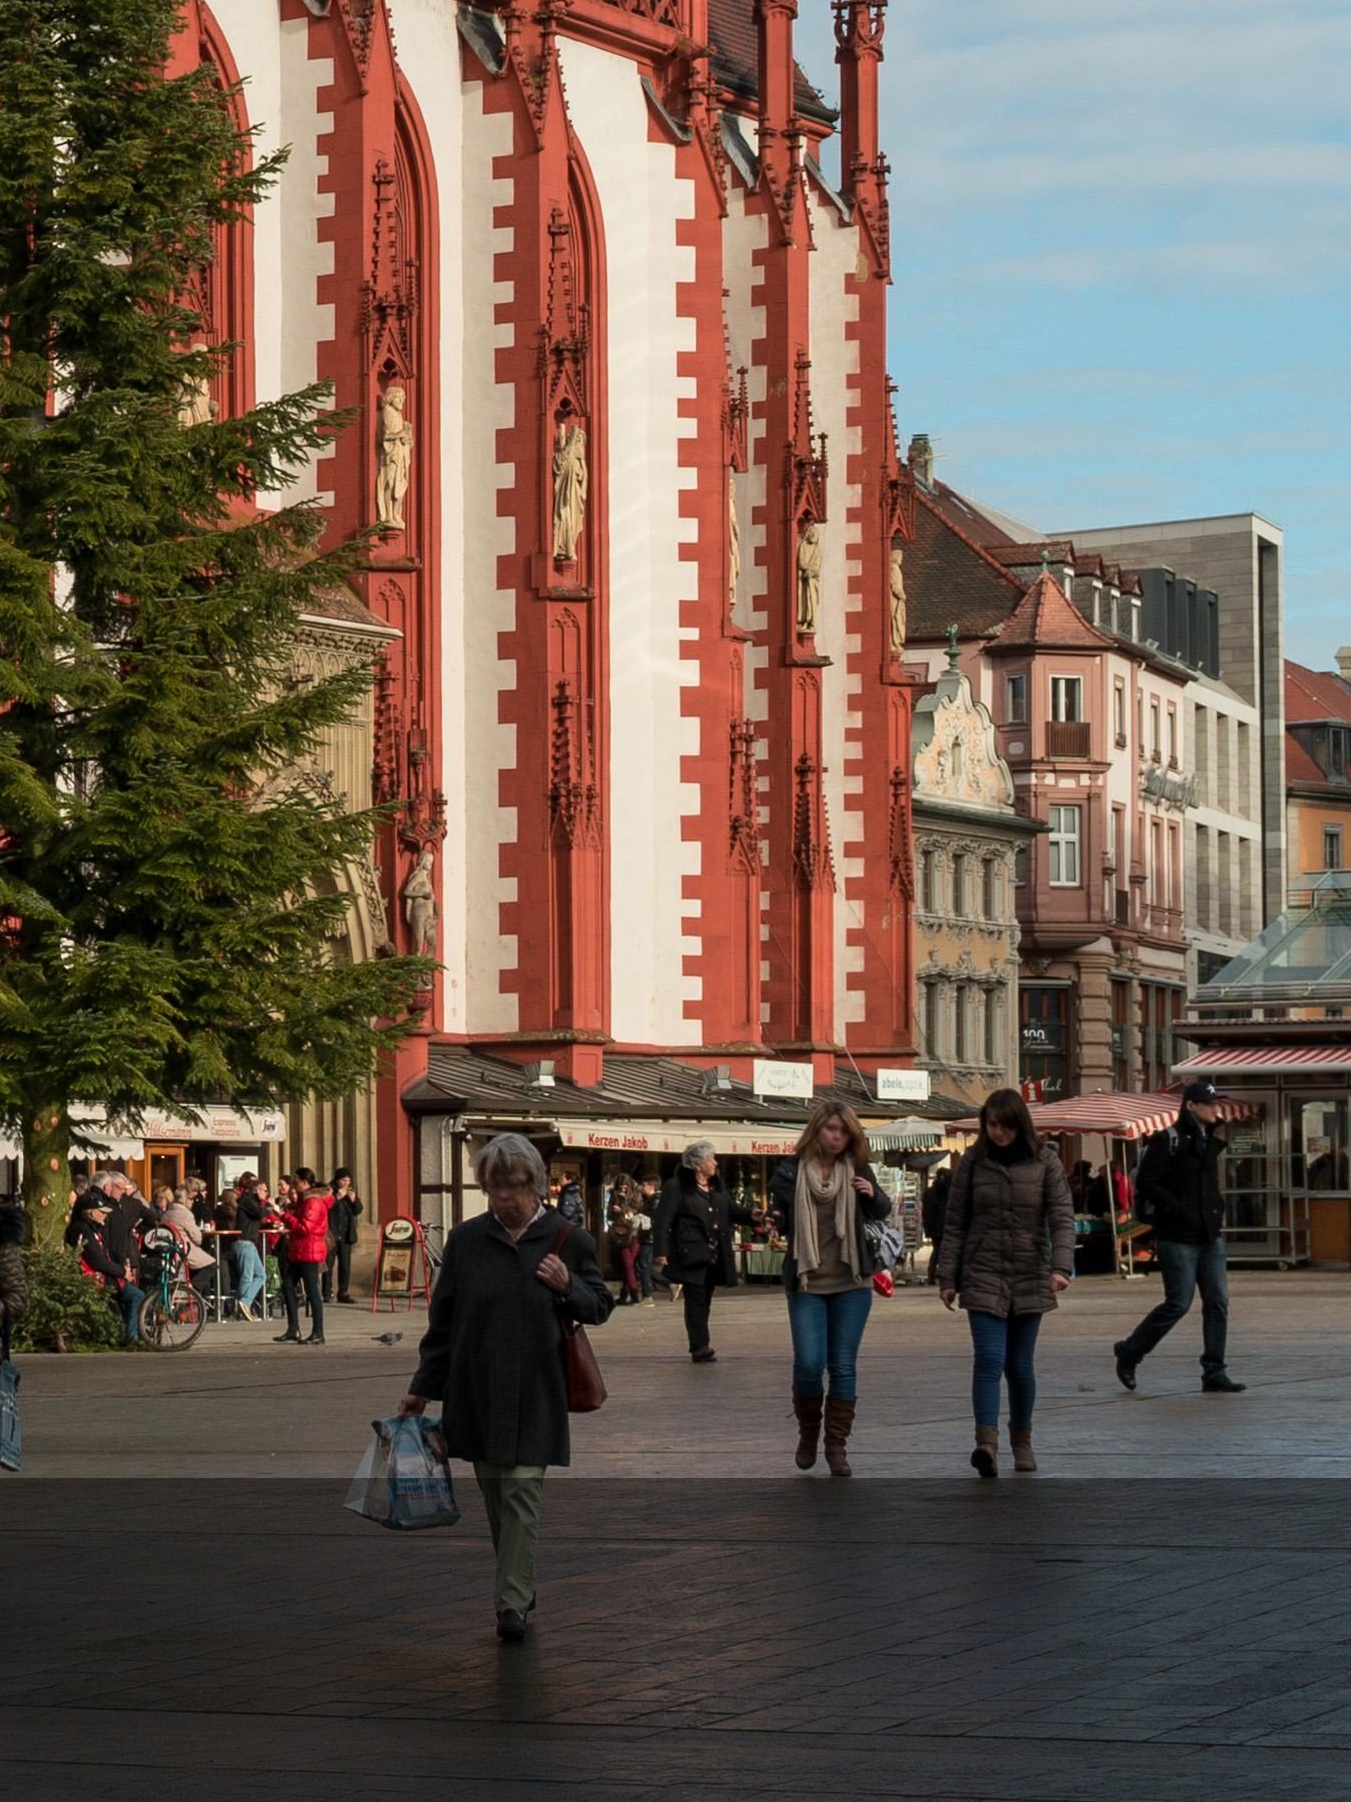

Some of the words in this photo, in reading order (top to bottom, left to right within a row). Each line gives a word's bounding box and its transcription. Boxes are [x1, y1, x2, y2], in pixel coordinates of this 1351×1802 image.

[588, 1133, 620, 1147] Kerzen
[622, 1135, 649, 1149] Jakob
[752, 1140, 780, 1154] Kerzen
